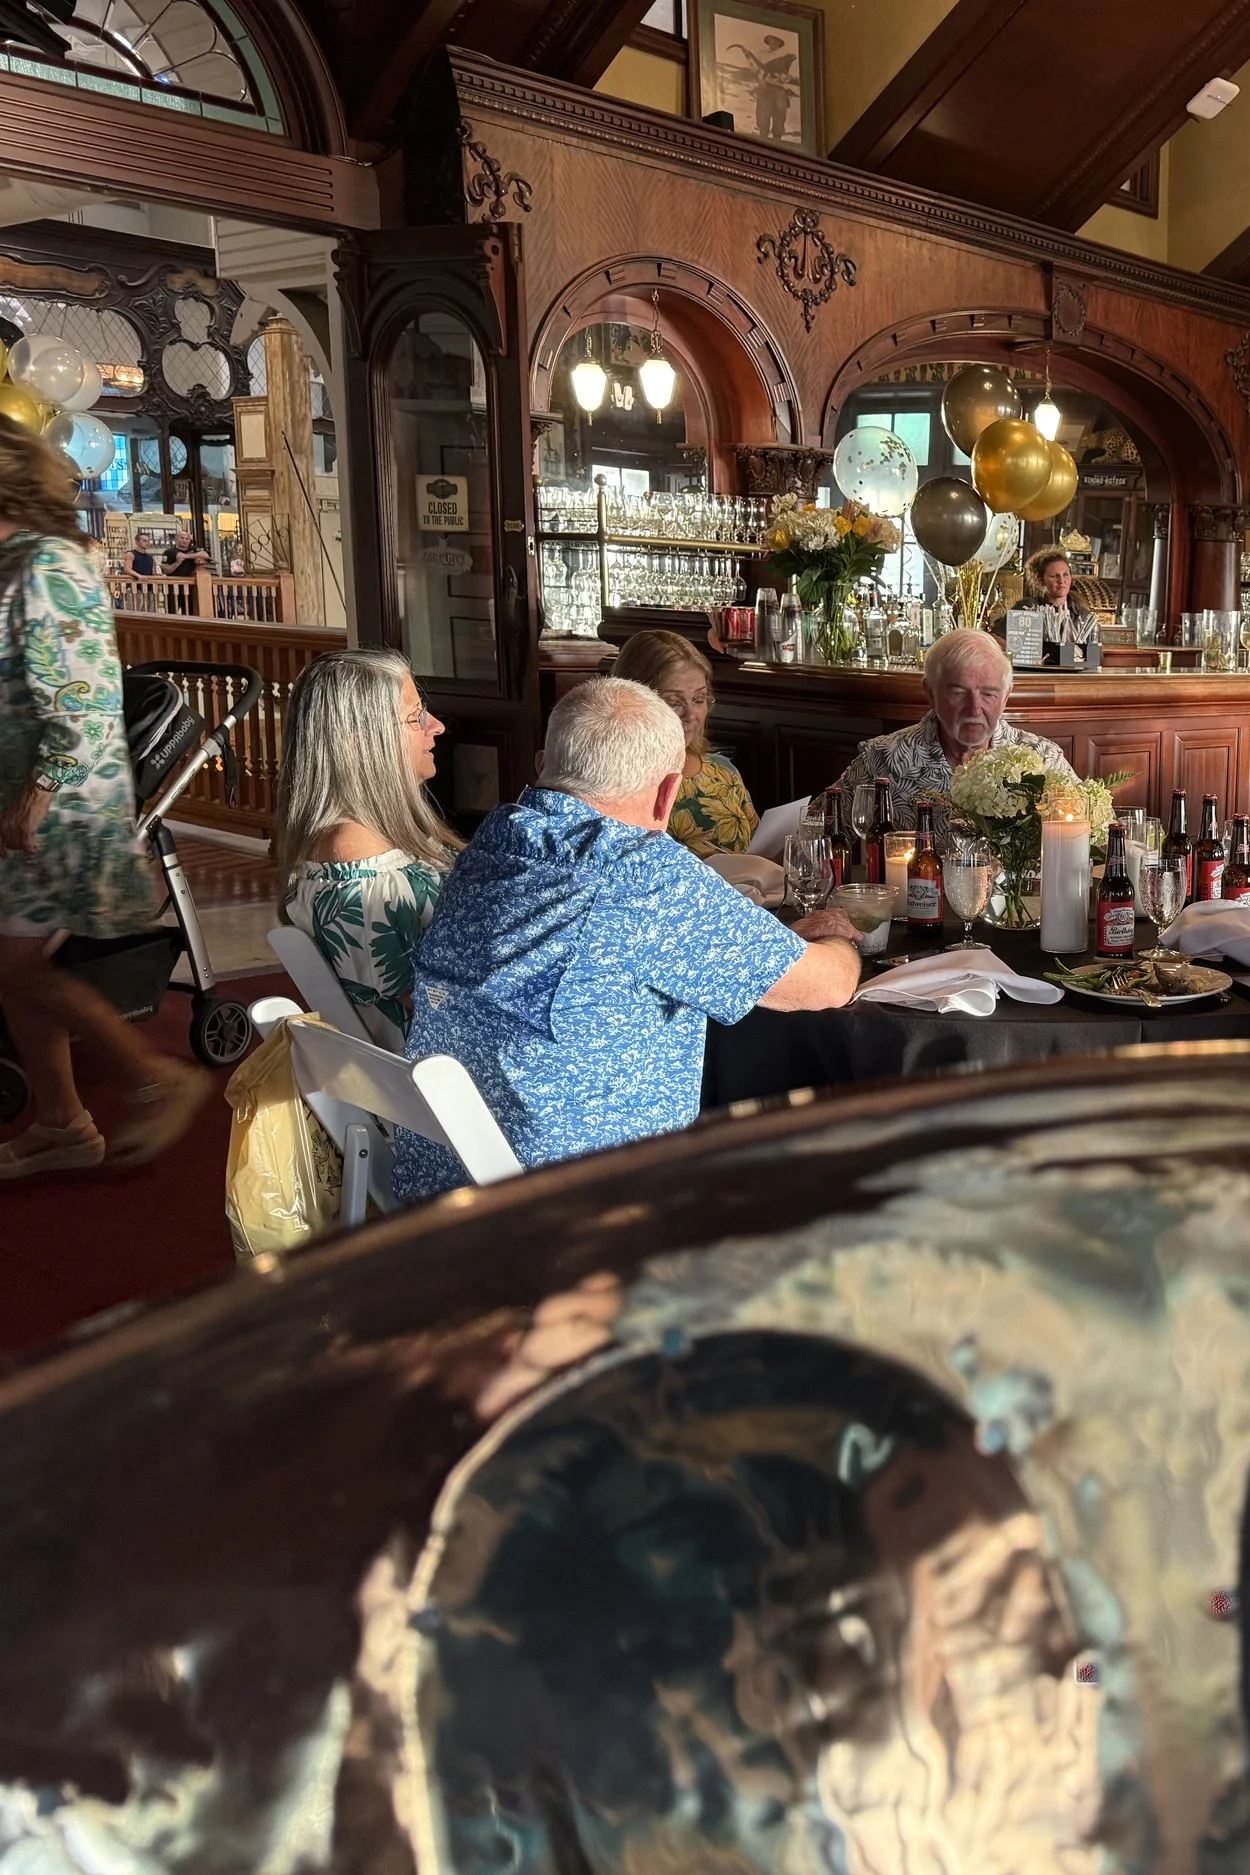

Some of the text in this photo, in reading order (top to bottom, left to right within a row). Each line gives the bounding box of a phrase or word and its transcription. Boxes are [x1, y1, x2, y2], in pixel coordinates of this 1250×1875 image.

[428, 501, 458, 515] CLOSED
[423, 514, 464, 526] TO THE PUBLIC
[1018, 616, 1031, 628] 80
